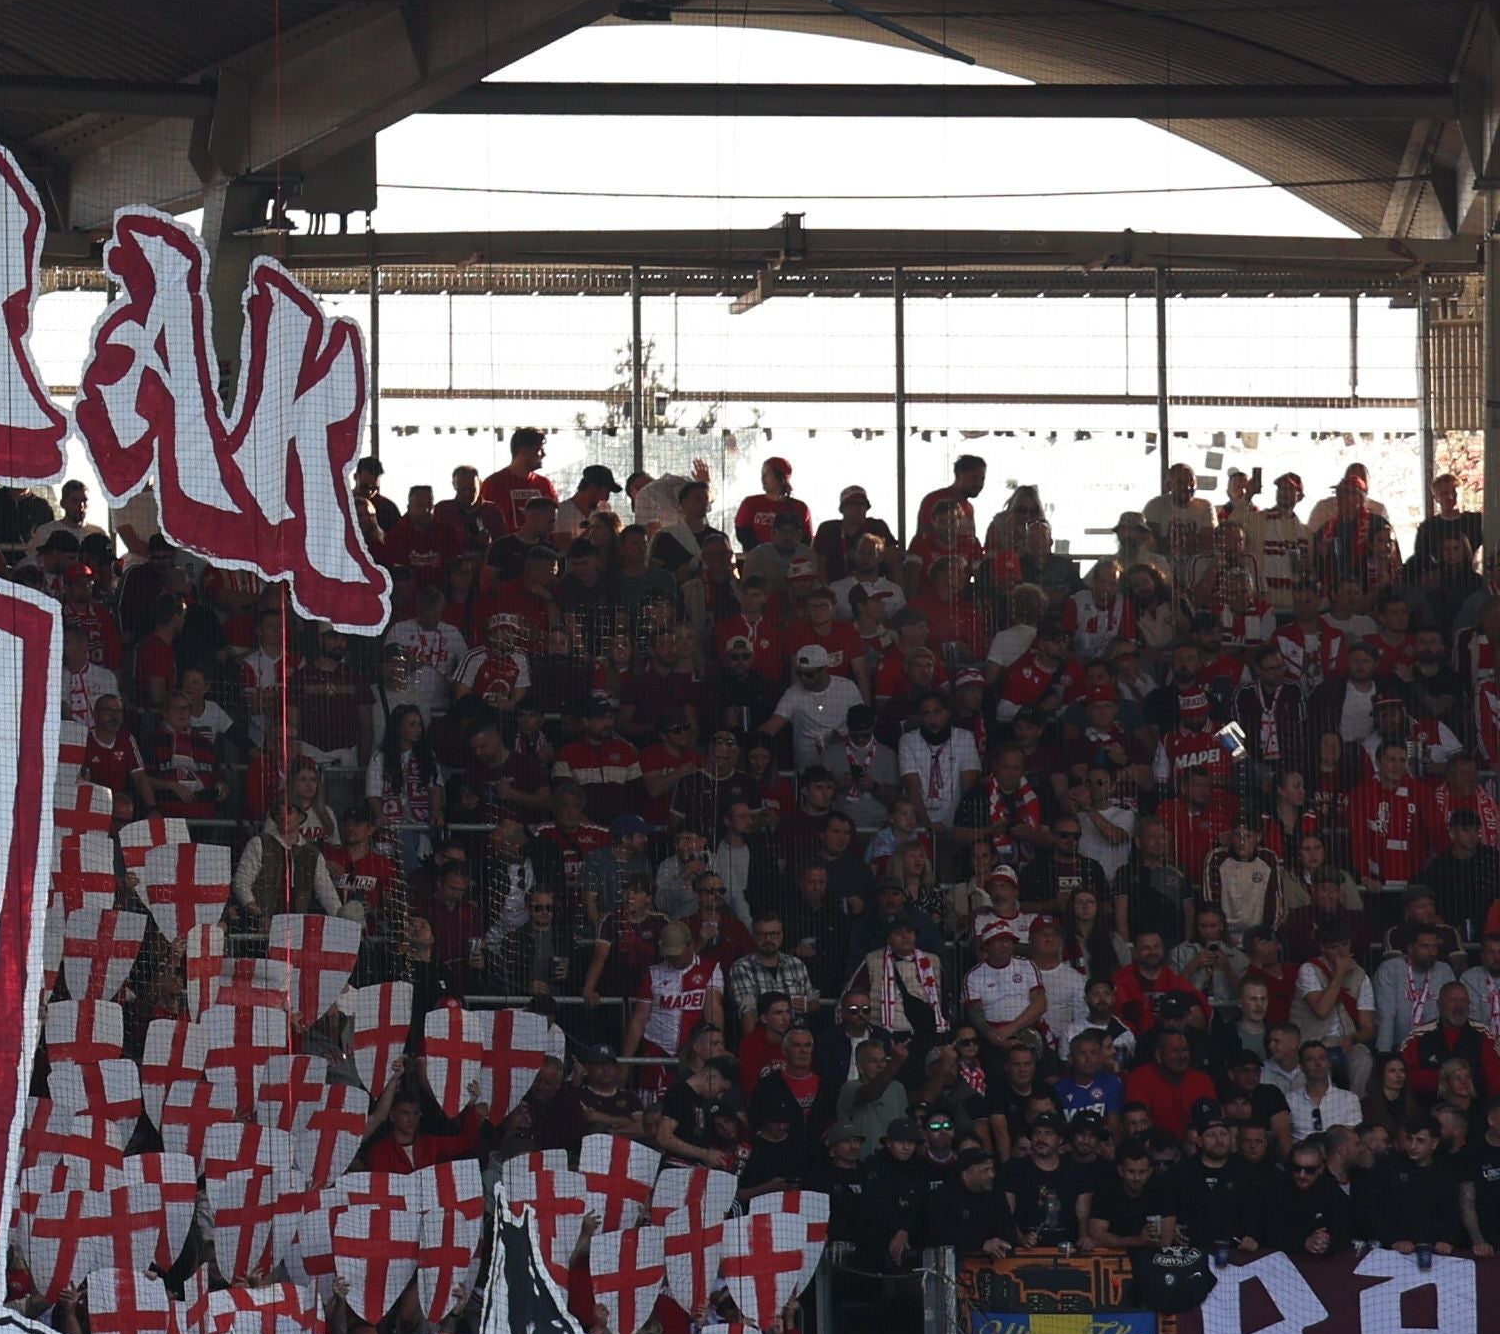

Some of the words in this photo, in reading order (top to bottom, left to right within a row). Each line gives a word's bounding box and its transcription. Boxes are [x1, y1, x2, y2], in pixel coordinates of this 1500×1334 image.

[75, 204, 392, 635] AK
[1174, 748, 1221, 769] MAPEI
[659, 991, 706, 1009] MAPEI
